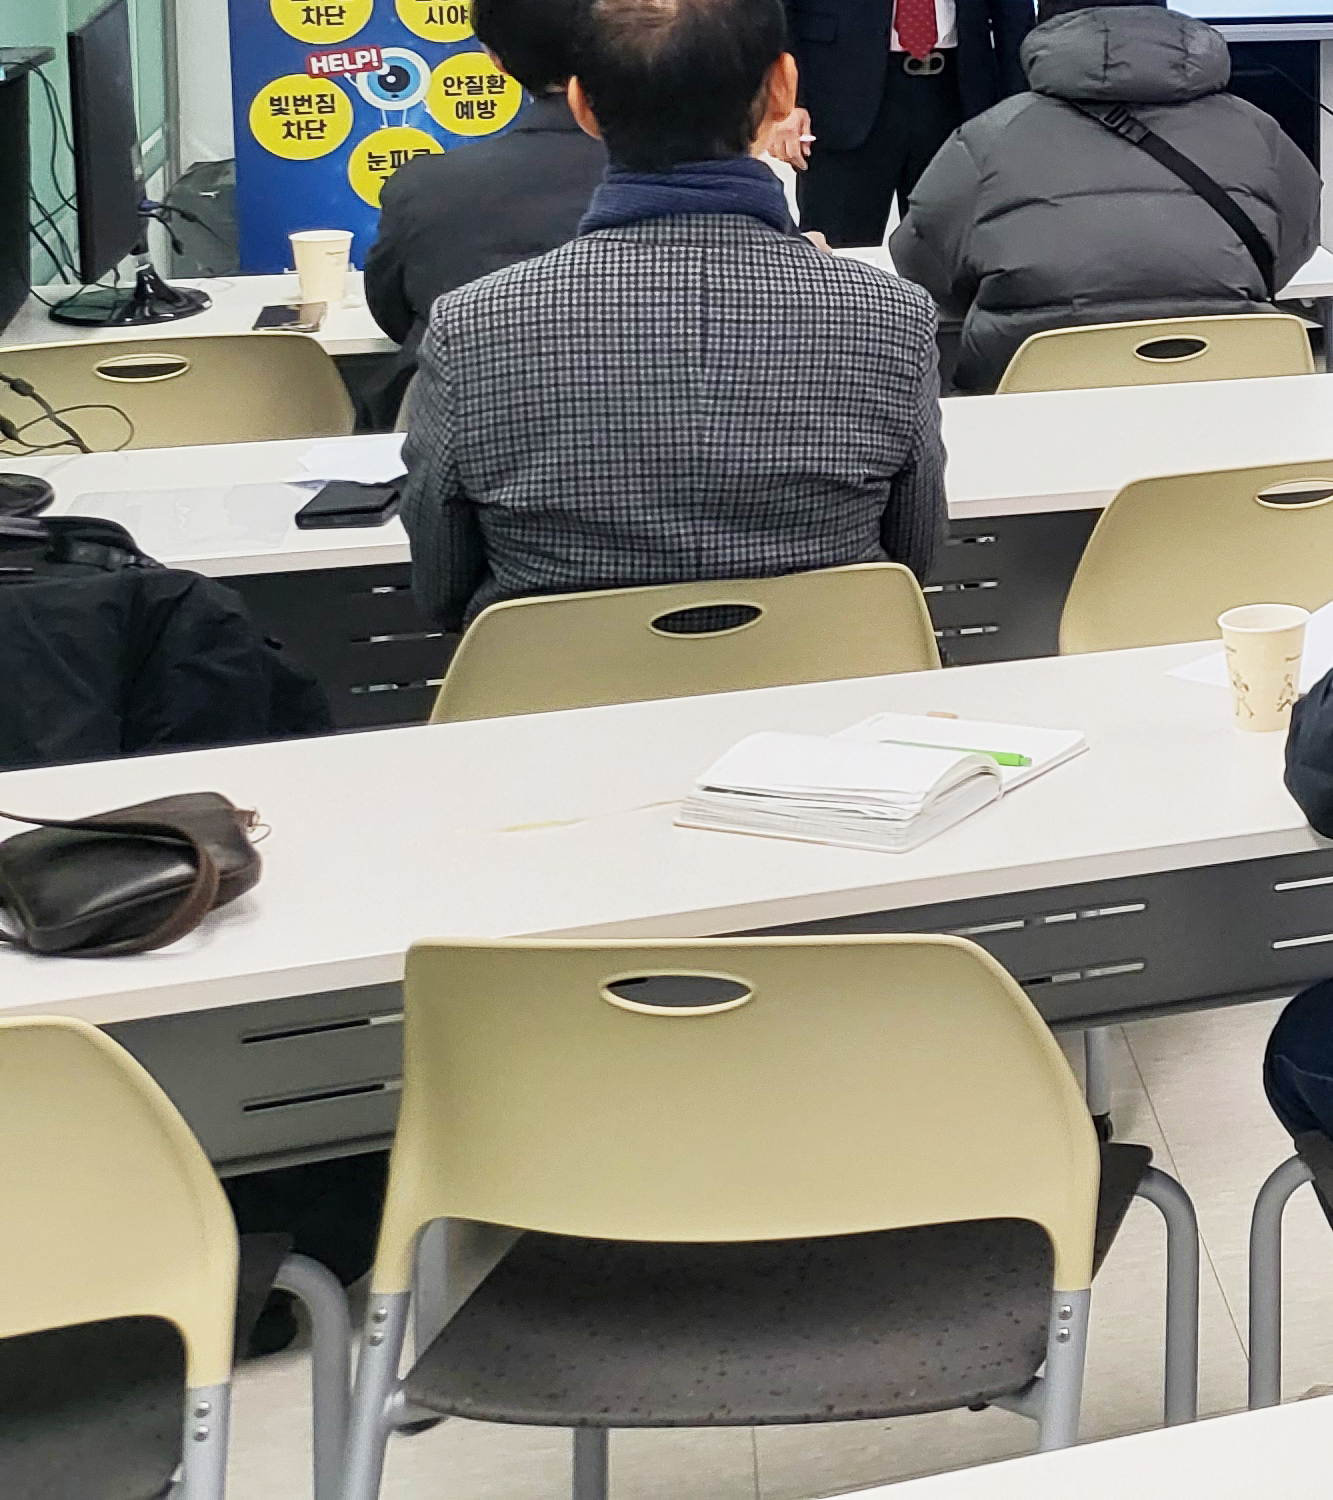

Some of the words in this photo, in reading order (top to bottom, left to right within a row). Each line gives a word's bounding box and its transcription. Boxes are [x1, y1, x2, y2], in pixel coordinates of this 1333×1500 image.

[301, 5, 346, 27] 차단
[424, 4, 469, 26] 시야
[309, 48, 380, 75] HELP!
[442, 75, 507, 97] 안질환
[269, 93, 336, 116] 빛번짐
[454, 100, 497, 121] 예방
[281, 119, 327, 141] 차단
